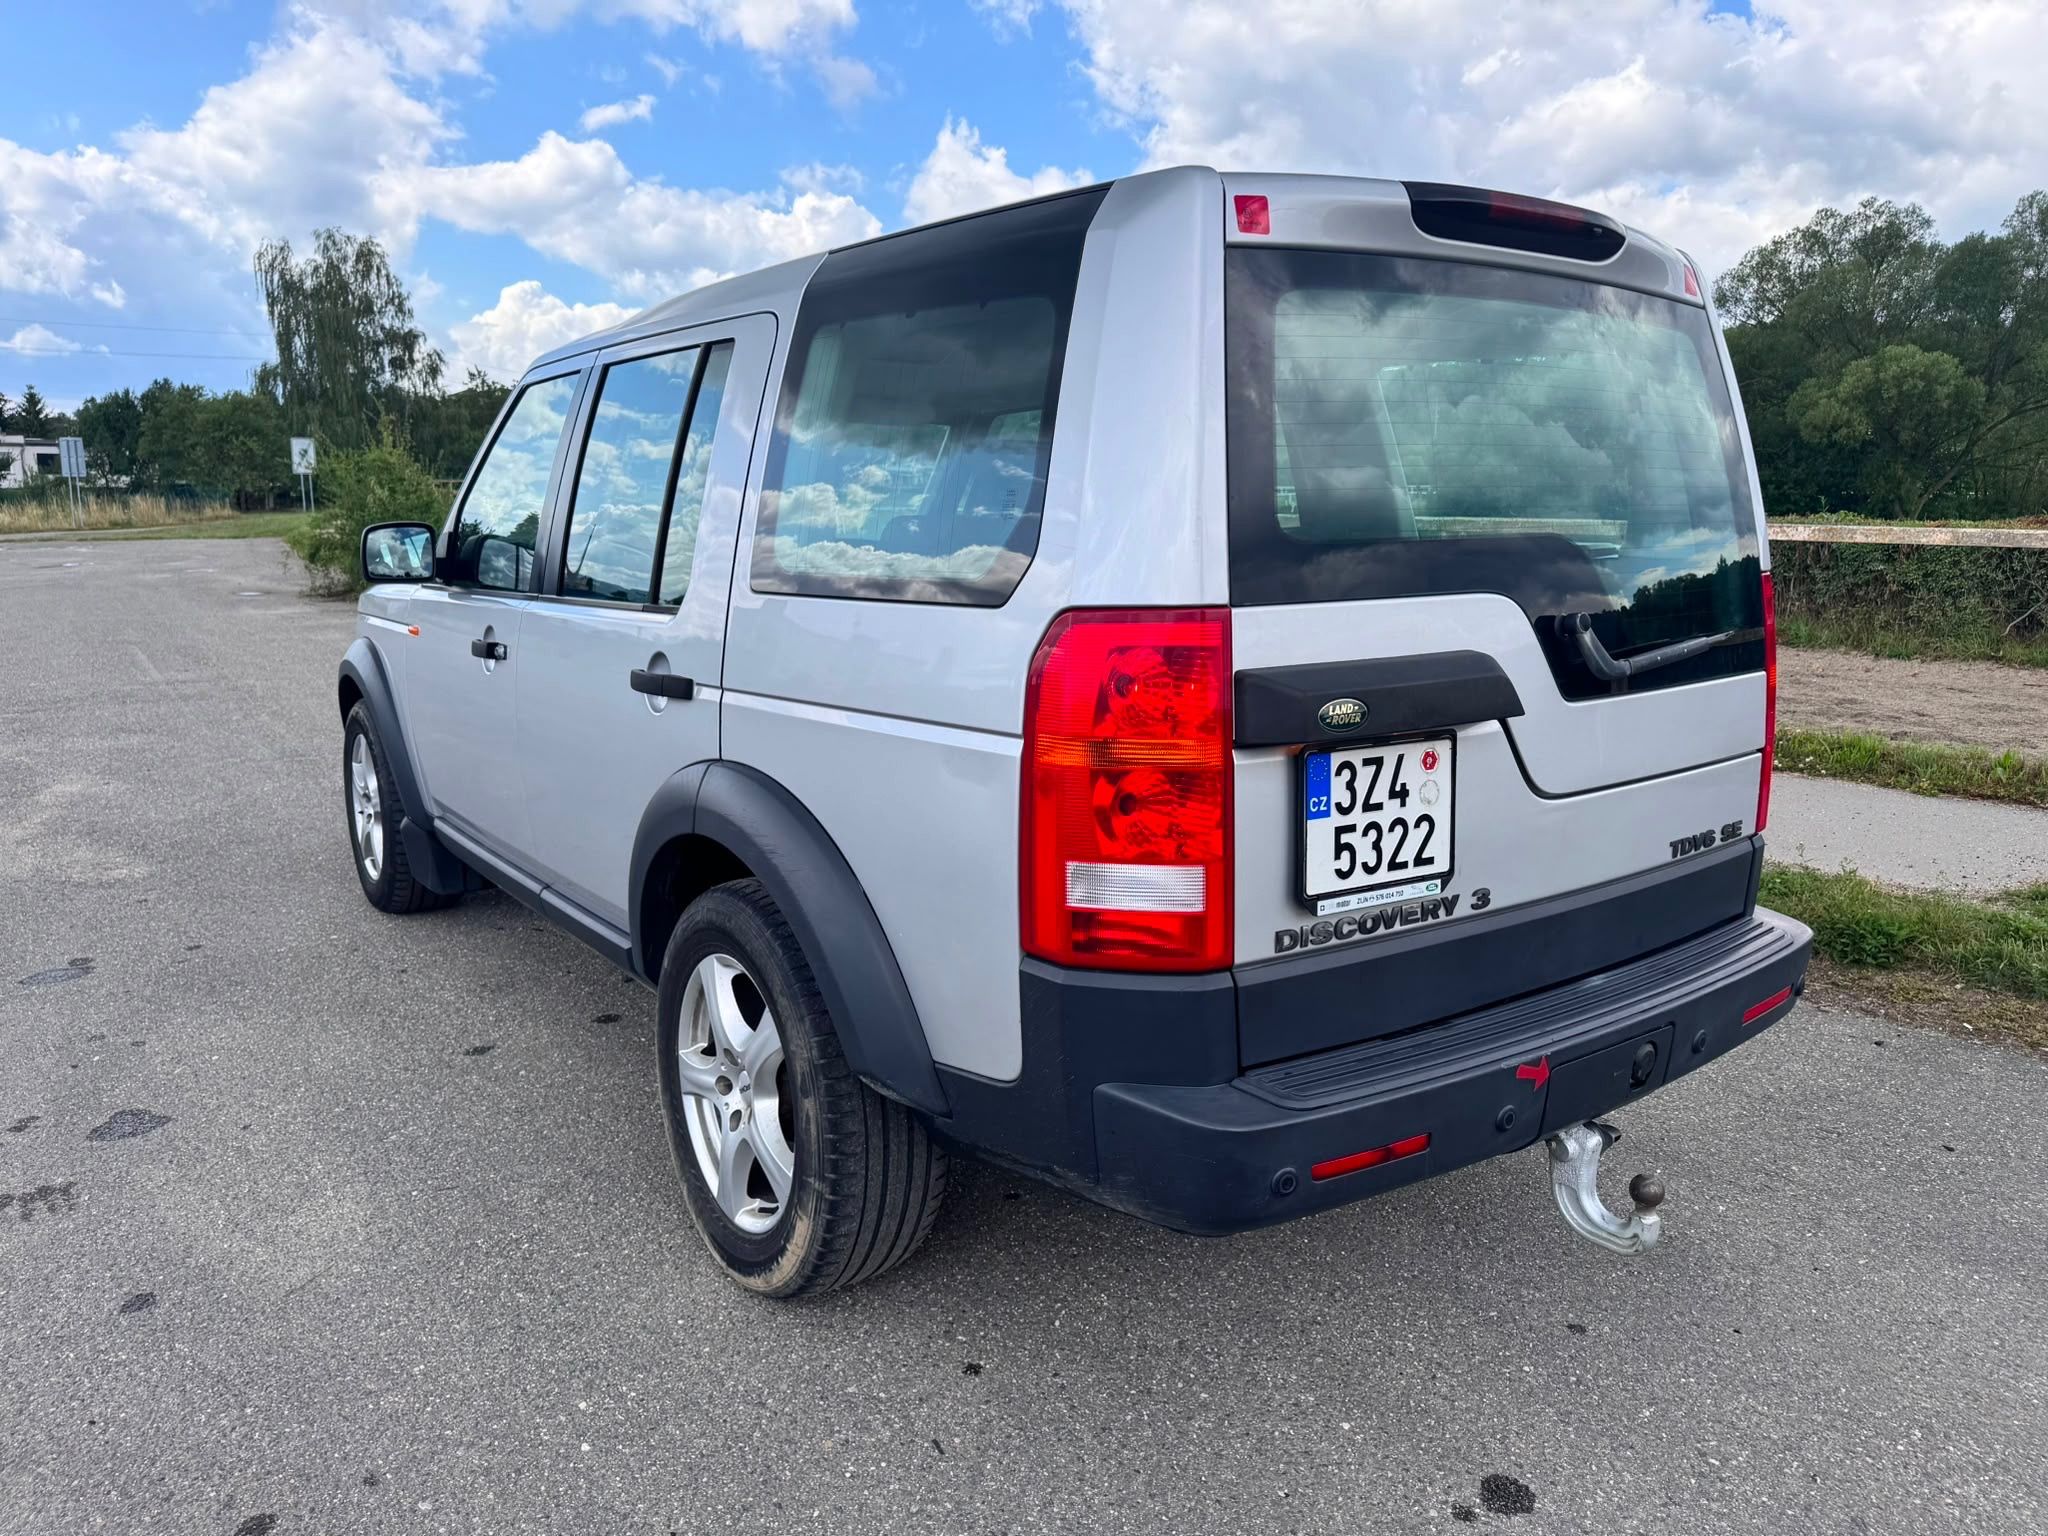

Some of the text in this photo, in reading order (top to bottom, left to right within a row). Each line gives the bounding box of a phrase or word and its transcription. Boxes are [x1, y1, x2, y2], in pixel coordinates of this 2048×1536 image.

[1329, 704, 1353, 715] LAND
[1331, 713, 1361, 725] ROVER
[1310, 796, 1327, 811] CZ
[1335, 753, 1409, 816] 3Z4
[1334, 813, 1435, 880] 5322
[1669, 820, 1743, 859] TDV6 SE
[1274, 887, 1491, 953] DISCOVERY 3
